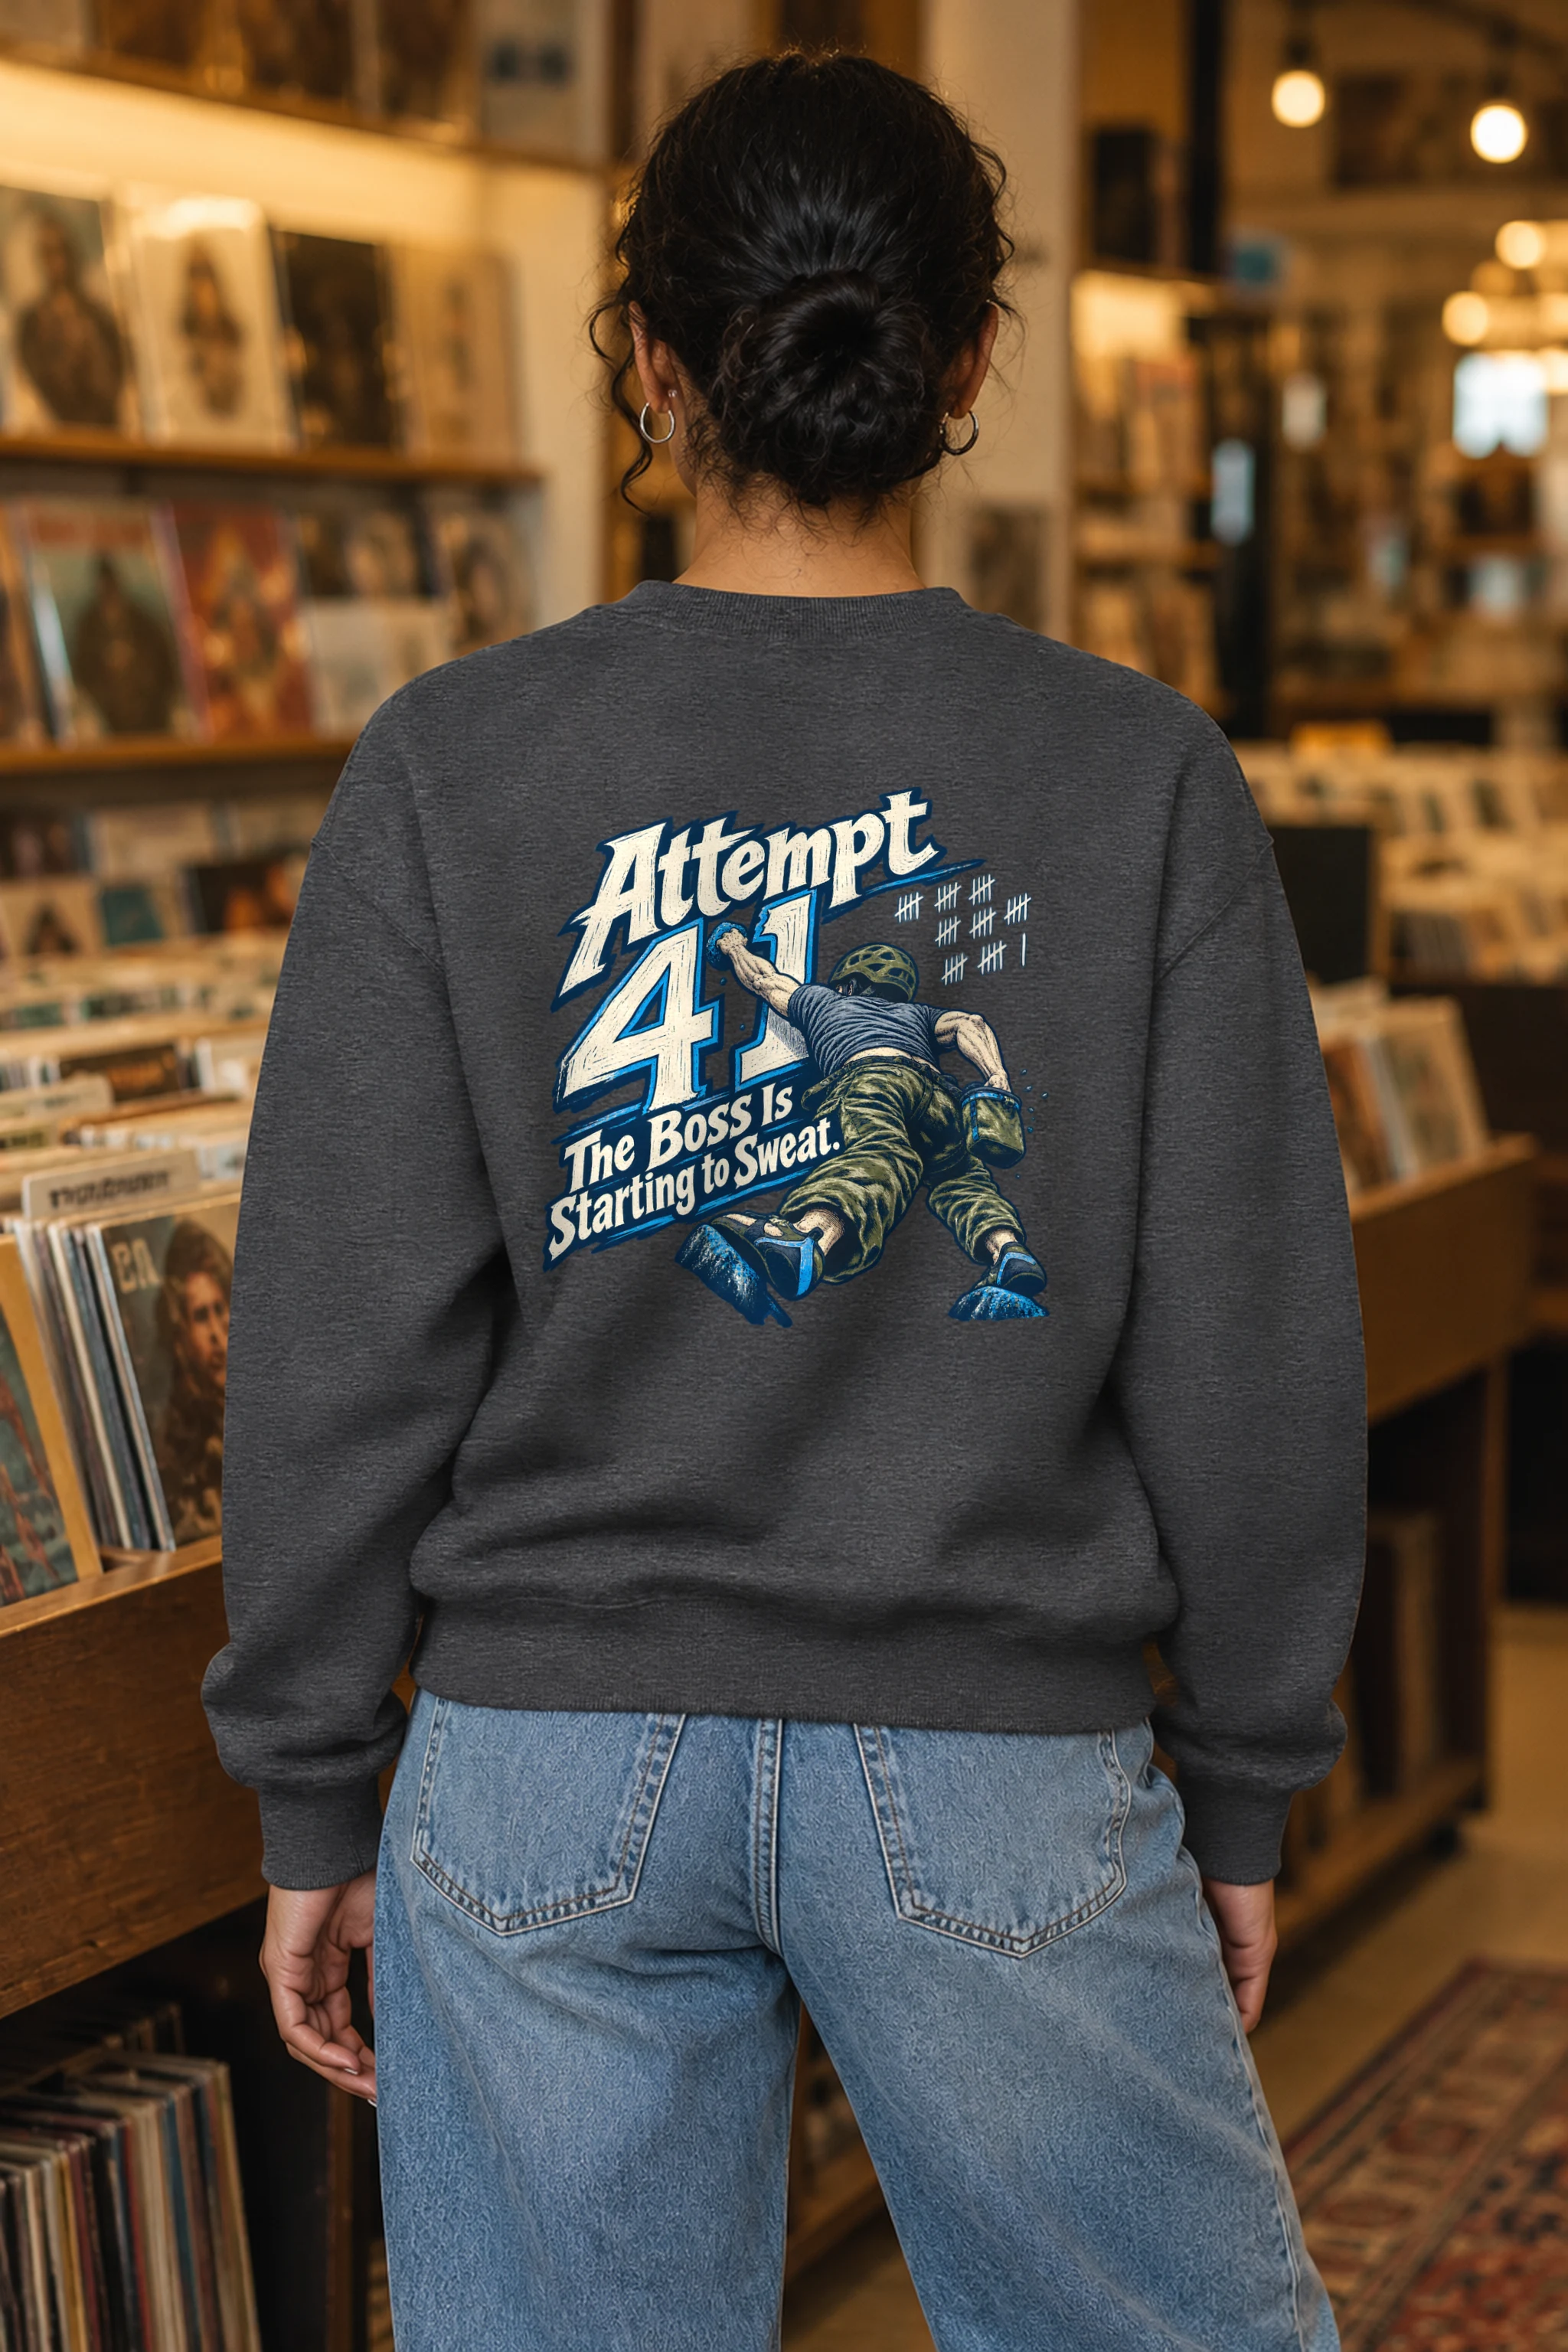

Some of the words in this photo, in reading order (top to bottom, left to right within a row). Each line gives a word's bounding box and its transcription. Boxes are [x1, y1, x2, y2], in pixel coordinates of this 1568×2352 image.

[560, 791, 939, 997] Attempt
[564, 894, 812, 1112] 41
[548, 1165, 695, 1261] Starting
[701, 1153, 730, 1194] to
[733, 1117, 841, 1189] Sweat.
[564, 1128, 635, 1194] The
[646, 1093, 752, 1171] Boss
[761, 1083, 793, 1126] Is
